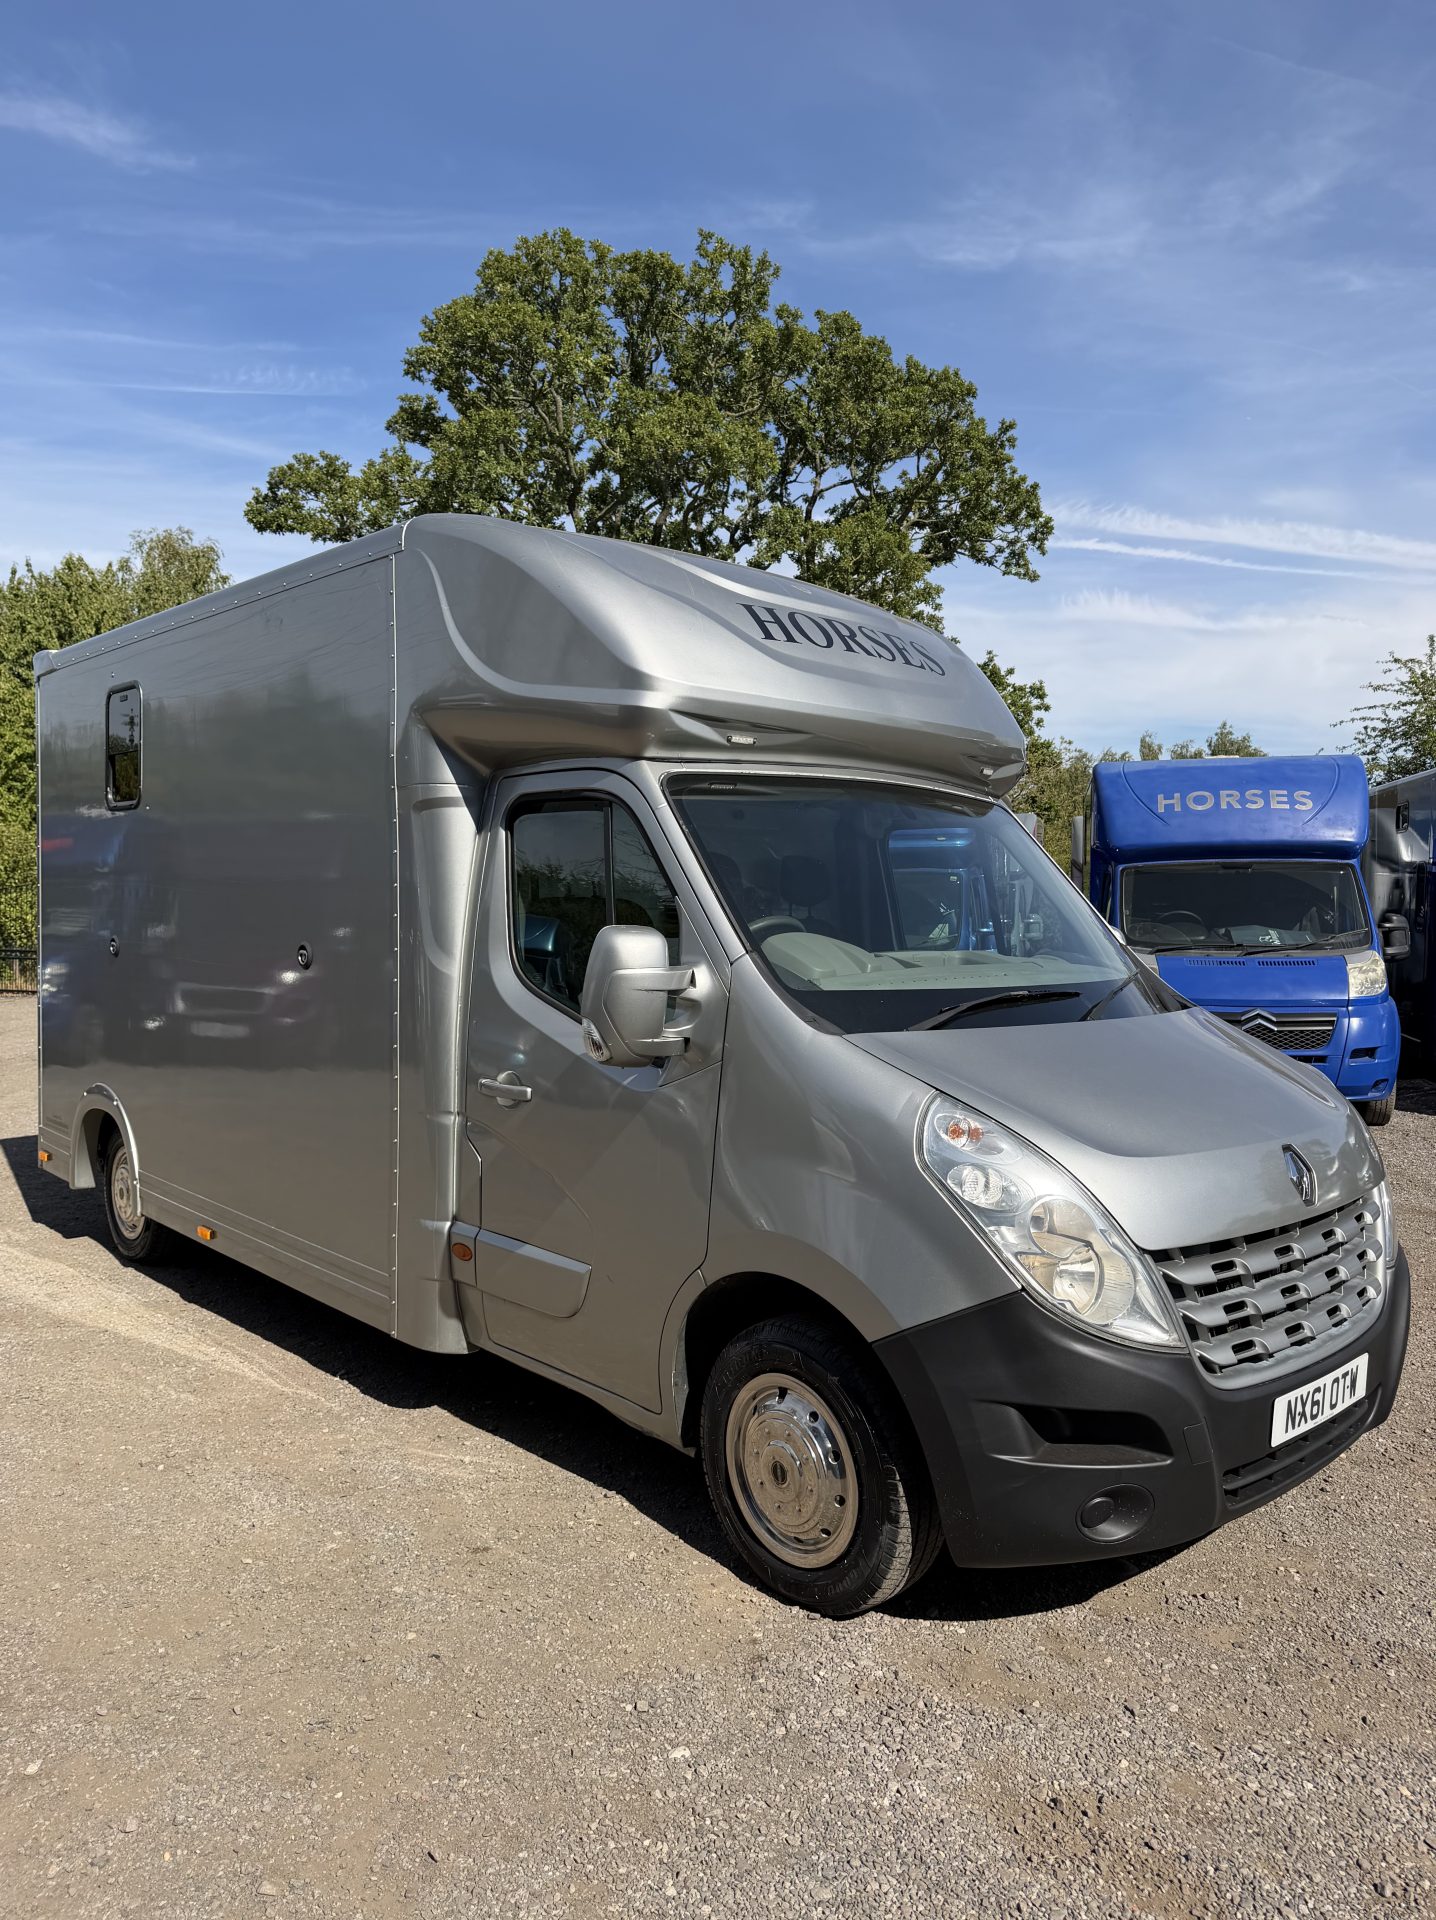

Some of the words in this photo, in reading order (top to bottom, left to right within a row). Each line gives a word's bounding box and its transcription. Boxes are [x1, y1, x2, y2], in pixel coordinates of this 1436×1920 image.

[736, 602, 946, 677] HORSES
[1157, 789, 1314, 813] HORSES
[1284, 1383, 1327, 1434] NX61
[1329, 1364, 1359, 1411] OTW
